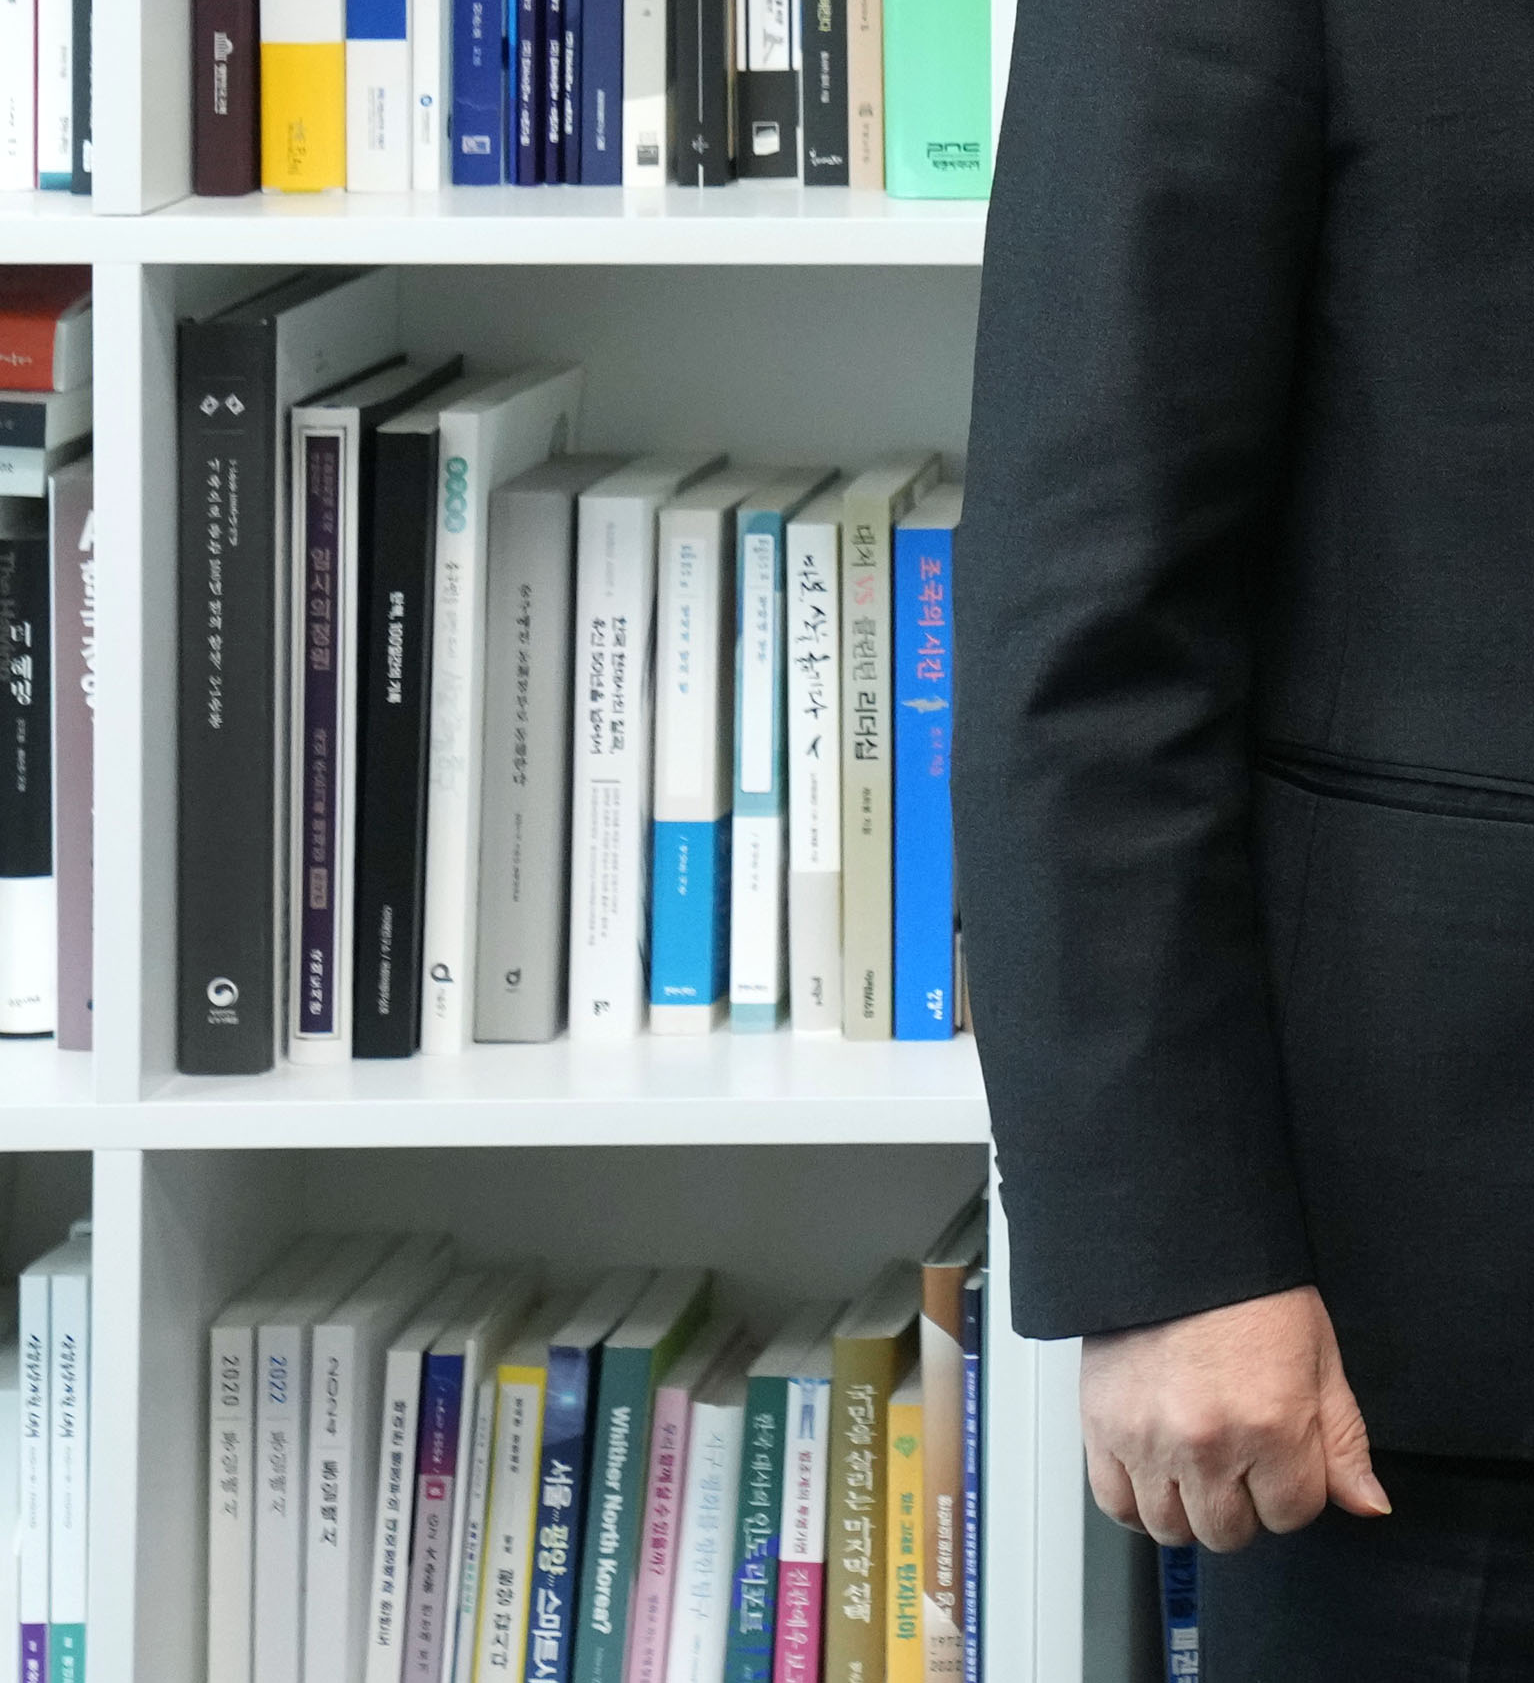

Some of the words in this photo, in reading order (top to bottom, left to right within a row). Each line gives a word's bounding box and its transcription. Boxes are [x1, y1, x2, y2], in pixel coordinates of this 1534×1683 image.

[854, 573, 876, 606] VS
[917, 556, 945, 627] 조국의
[917, 632, 946, 682] 시간
[853, 690, 879, 762] 리더십
[220, 1354, 240, 1406] 2020
[268, 1355, 288, 1405] 2022
[604, 1405, 631, 1487] Whither
[542, 1459, 574, 1508] 서울
[538, 1524, 569, 1575] 평양
[599, 1493, 624, 1554] North
[592, 1558, 621, 1634] Korea?
[895, 1564, 918, 1640] 탄자니아
